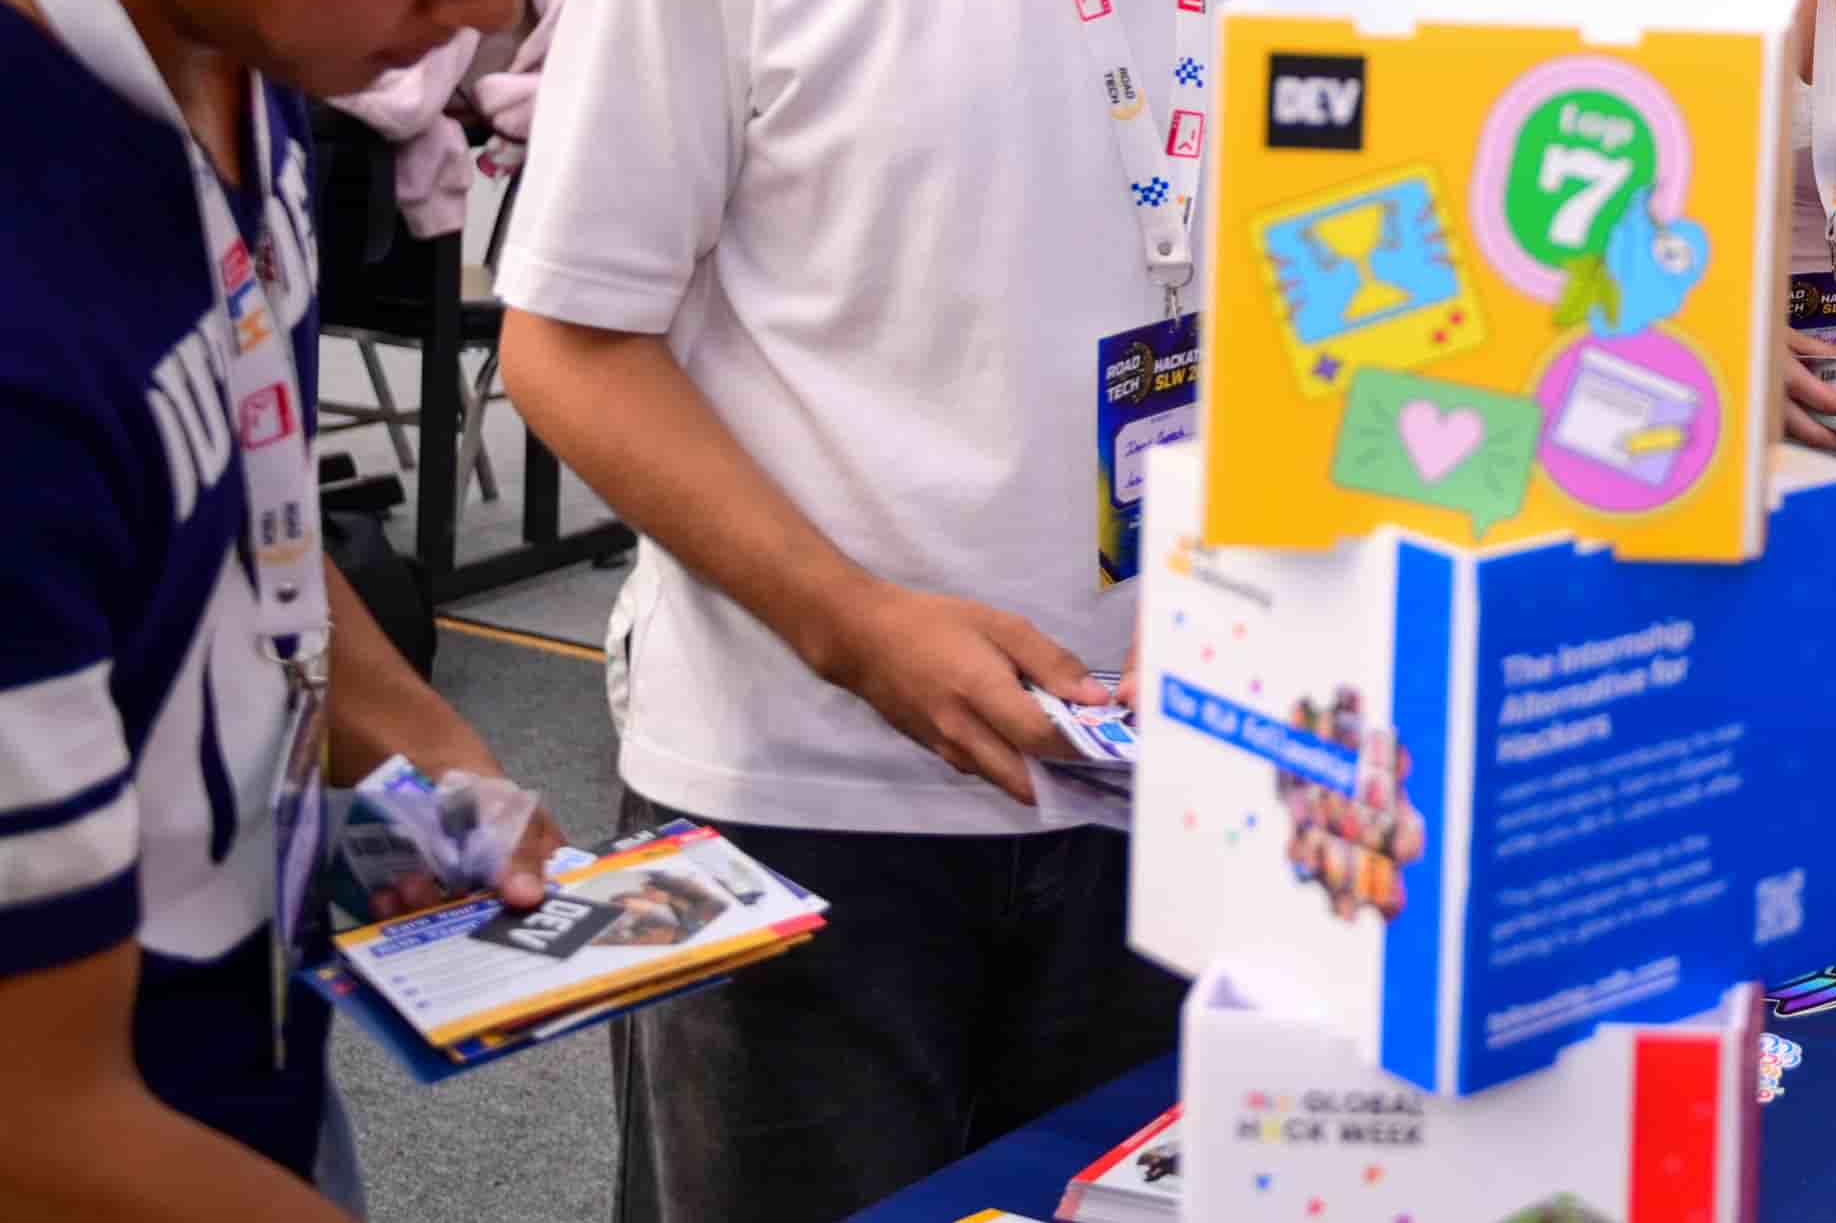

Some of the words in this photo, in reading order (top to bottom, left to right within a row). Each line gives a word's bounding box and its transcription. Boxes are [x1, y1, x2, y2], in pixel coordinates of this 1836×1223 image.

[1271, 76, 1361, 127] DEV
[1538, 144, 1635, 249] 7
[1107, 376, 1140, 403] TECH
[1235, 1118, 1324, 1143] HCK
